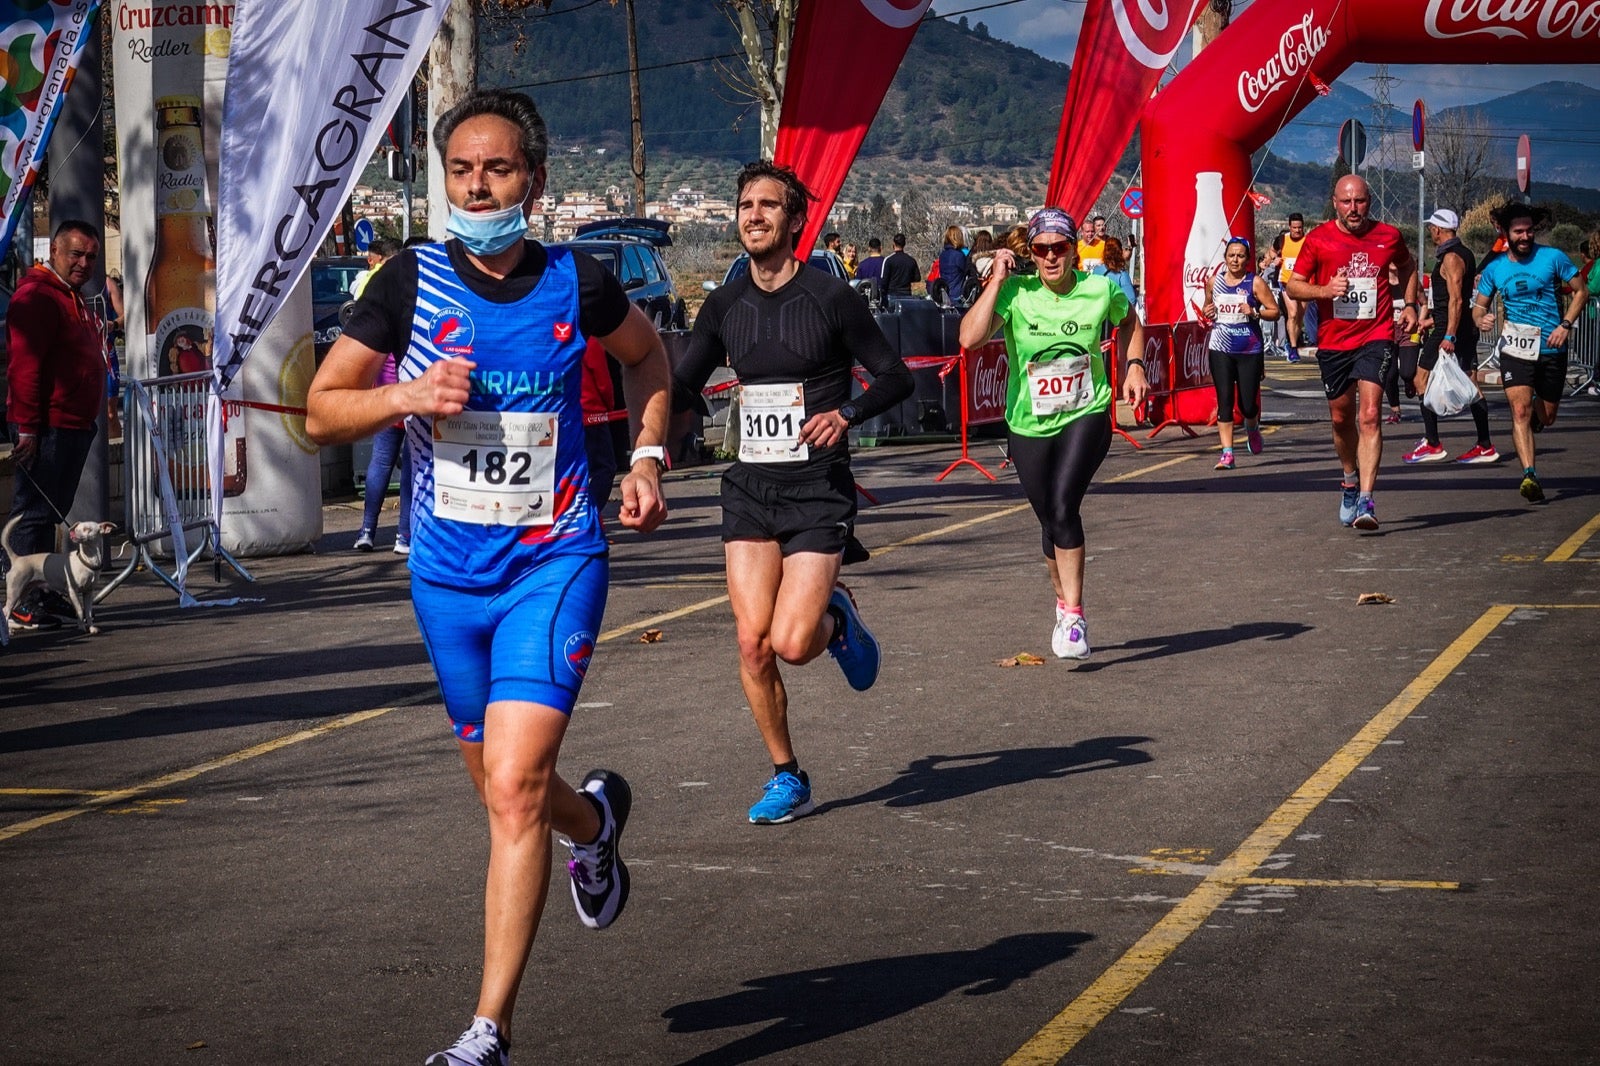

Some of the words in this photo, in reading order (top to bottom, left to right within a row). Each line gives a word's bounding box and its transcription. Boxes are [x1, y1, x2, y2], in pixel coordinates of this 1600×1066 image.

[119, 2, 235, 31] Cruzcamp
[128, 36, 192, 63] Radler
[1238, 8, 1328, 113] Coca-Cola
[9, 1, 88, 204] www.turgranada.es
[159, 172, 204, 189] Radler
[1505, 334, 1536, 350] 3107
[469, 370, 565, 396] NRIALIA
[1036, 371, 1085, 396] 2077
[746, 413, 793, 438] 3101
[462, 449, 532, 485] 182
